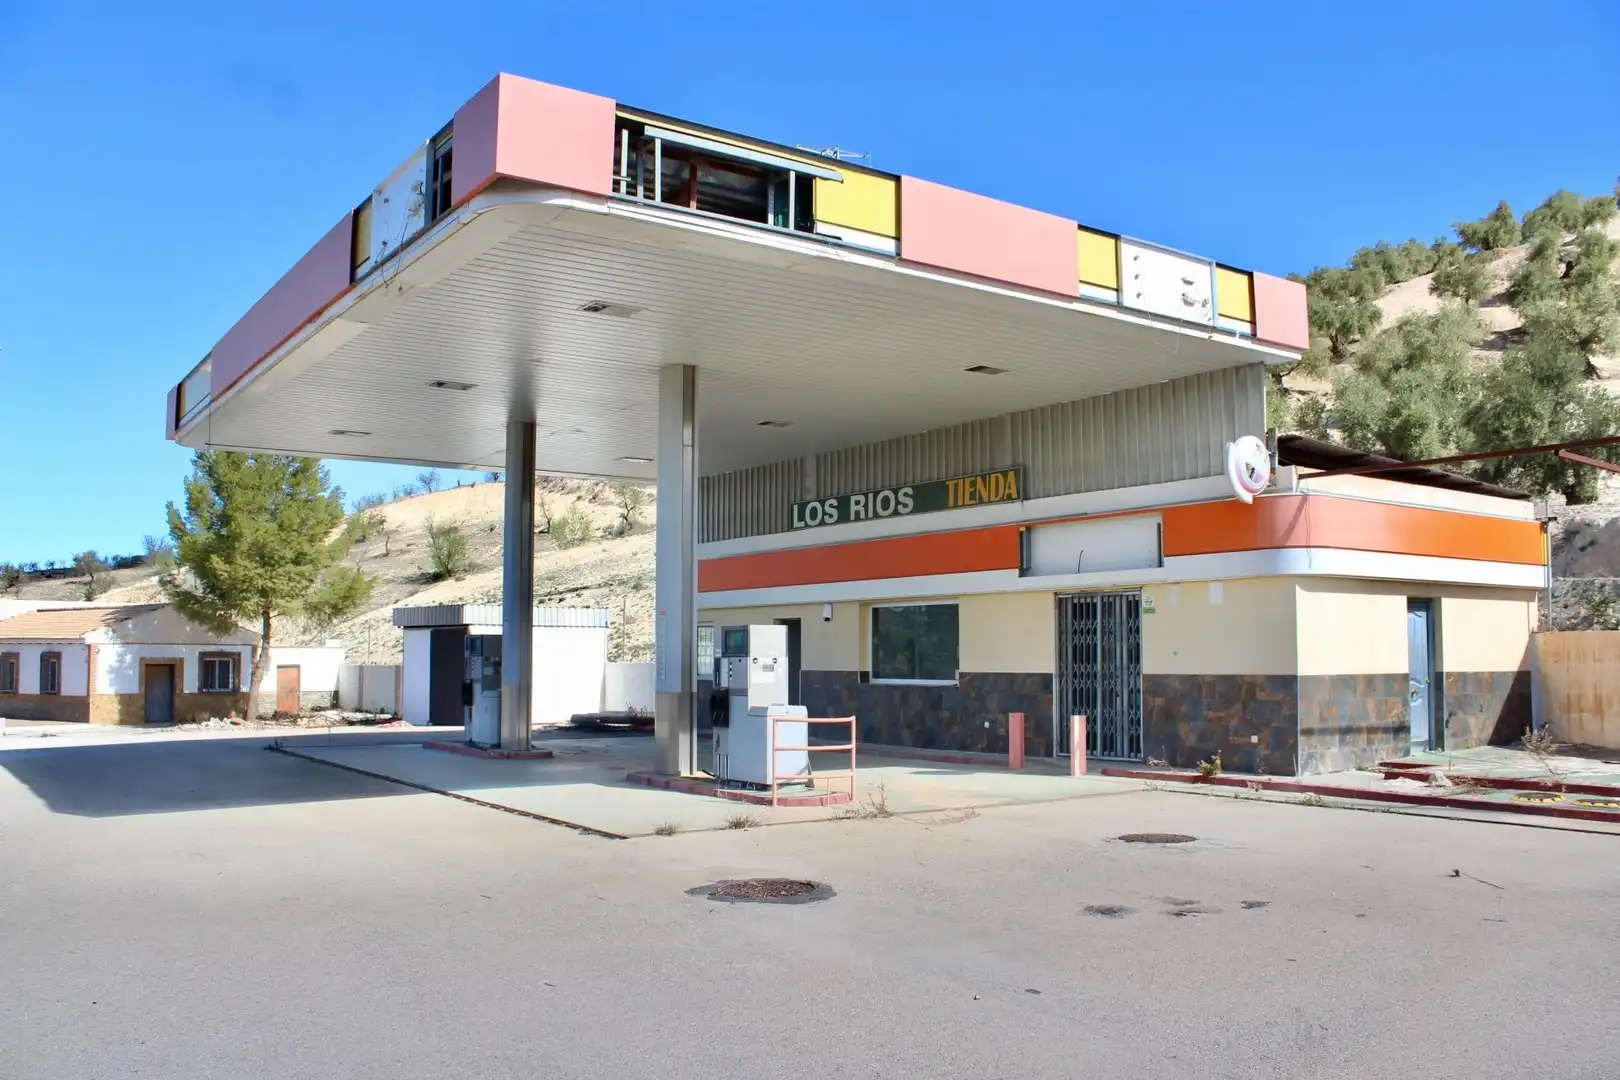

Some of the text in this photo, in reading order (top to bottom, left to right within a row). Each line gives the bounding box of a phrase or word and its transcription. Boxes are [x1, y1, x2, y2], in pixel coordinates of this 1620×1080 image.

[793, 470, 1018, 529] LOS RIOS TIENDA
